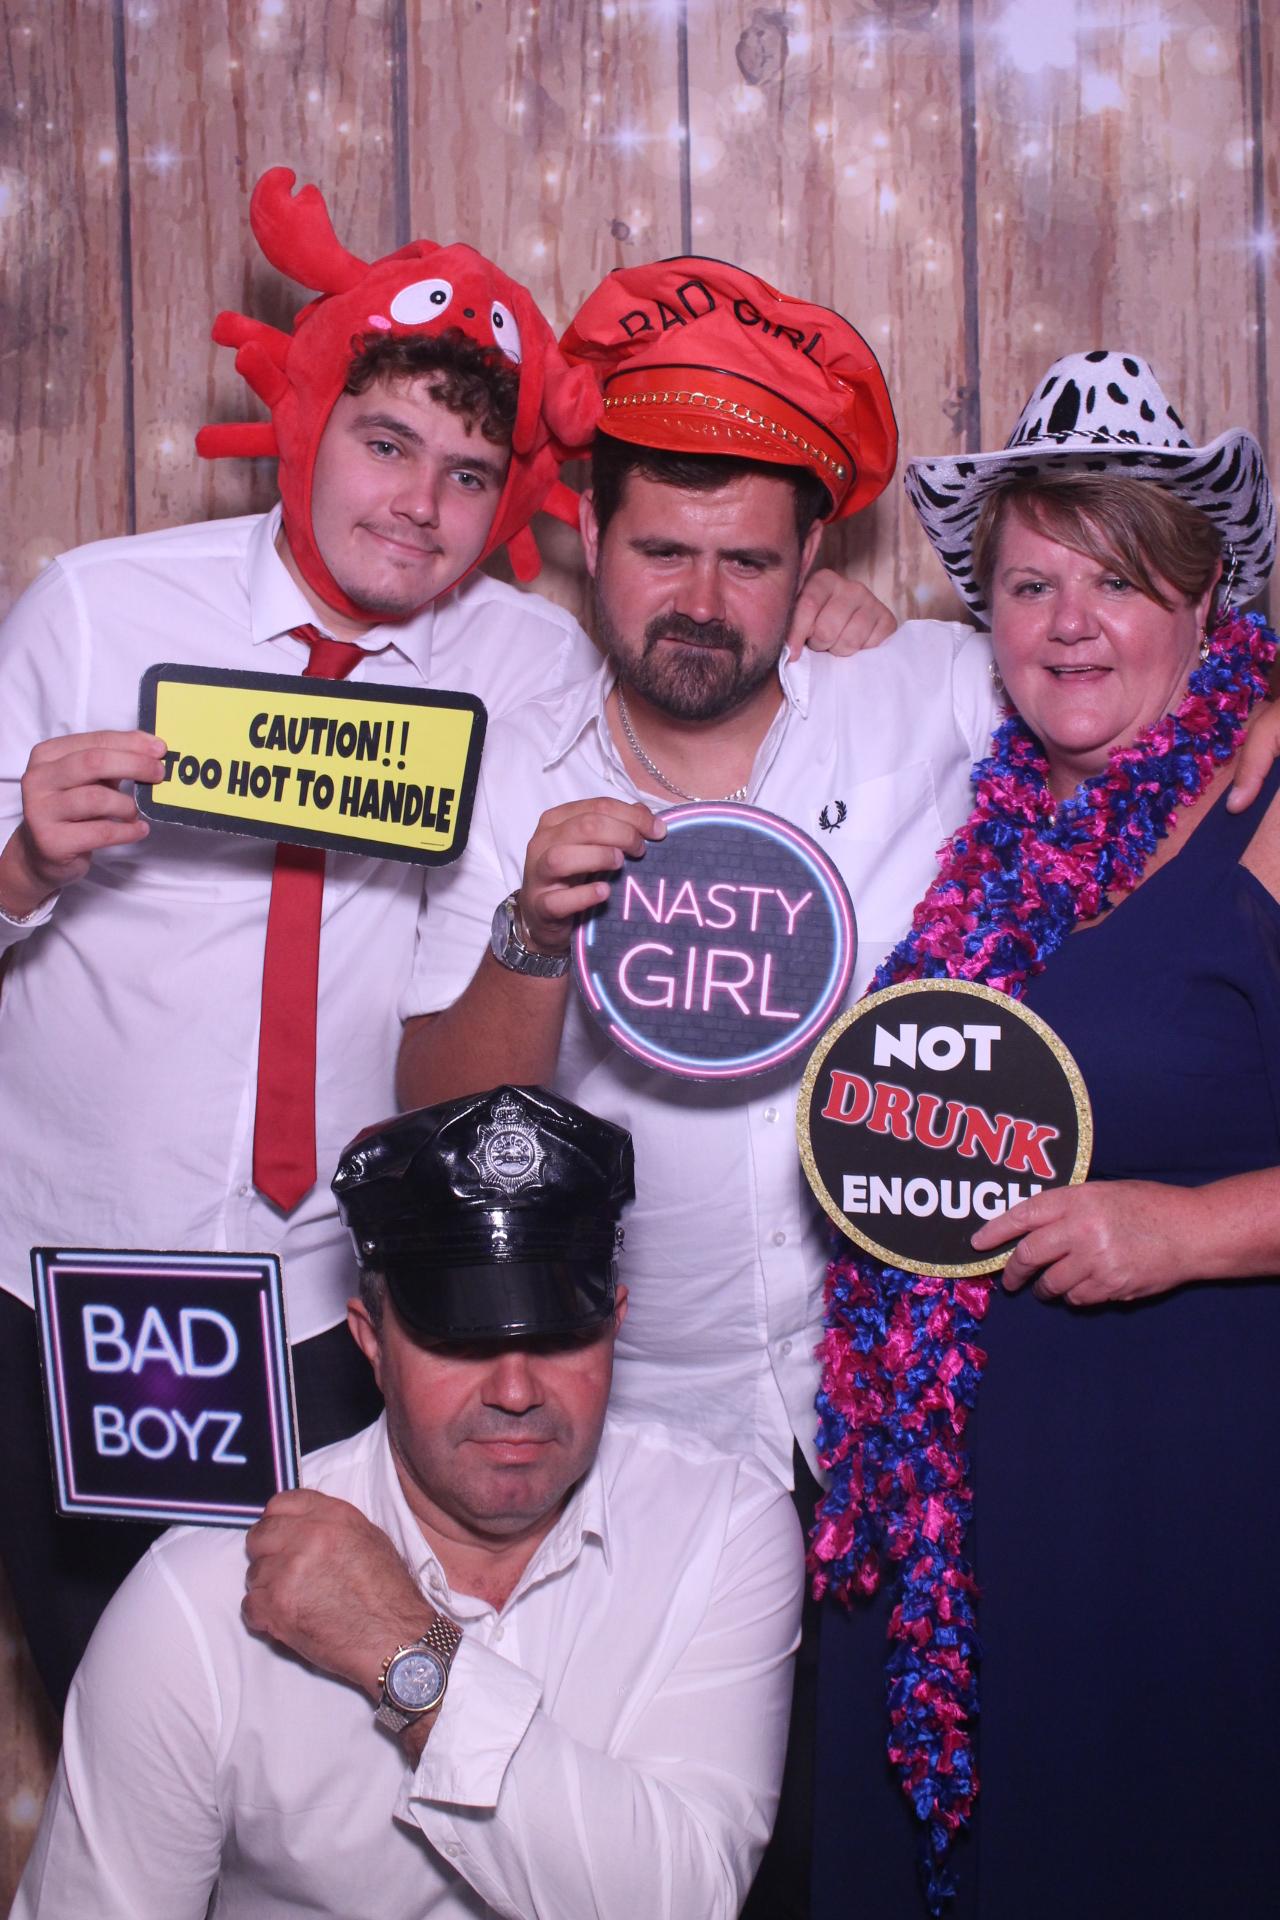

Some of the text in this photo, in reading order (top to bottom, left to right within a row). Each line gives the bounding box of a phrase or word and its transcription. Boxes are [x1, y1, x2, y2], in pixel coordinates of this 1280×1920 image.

[249, 712, 410, 770] CAUTION!!
[162, 750, 455, 833] TOO HOT TO HANDLE
[623, 875, 813, 935] NASTY
[618, 943, 800, 1019] GIRL
[873, 1023, 1001, 1071] NOT
[821, 1069, 1060, 1179] DRUNK
[82, 1304, 239, 1377] BAD
[93, 1404, 247, 1464] BOYZ
